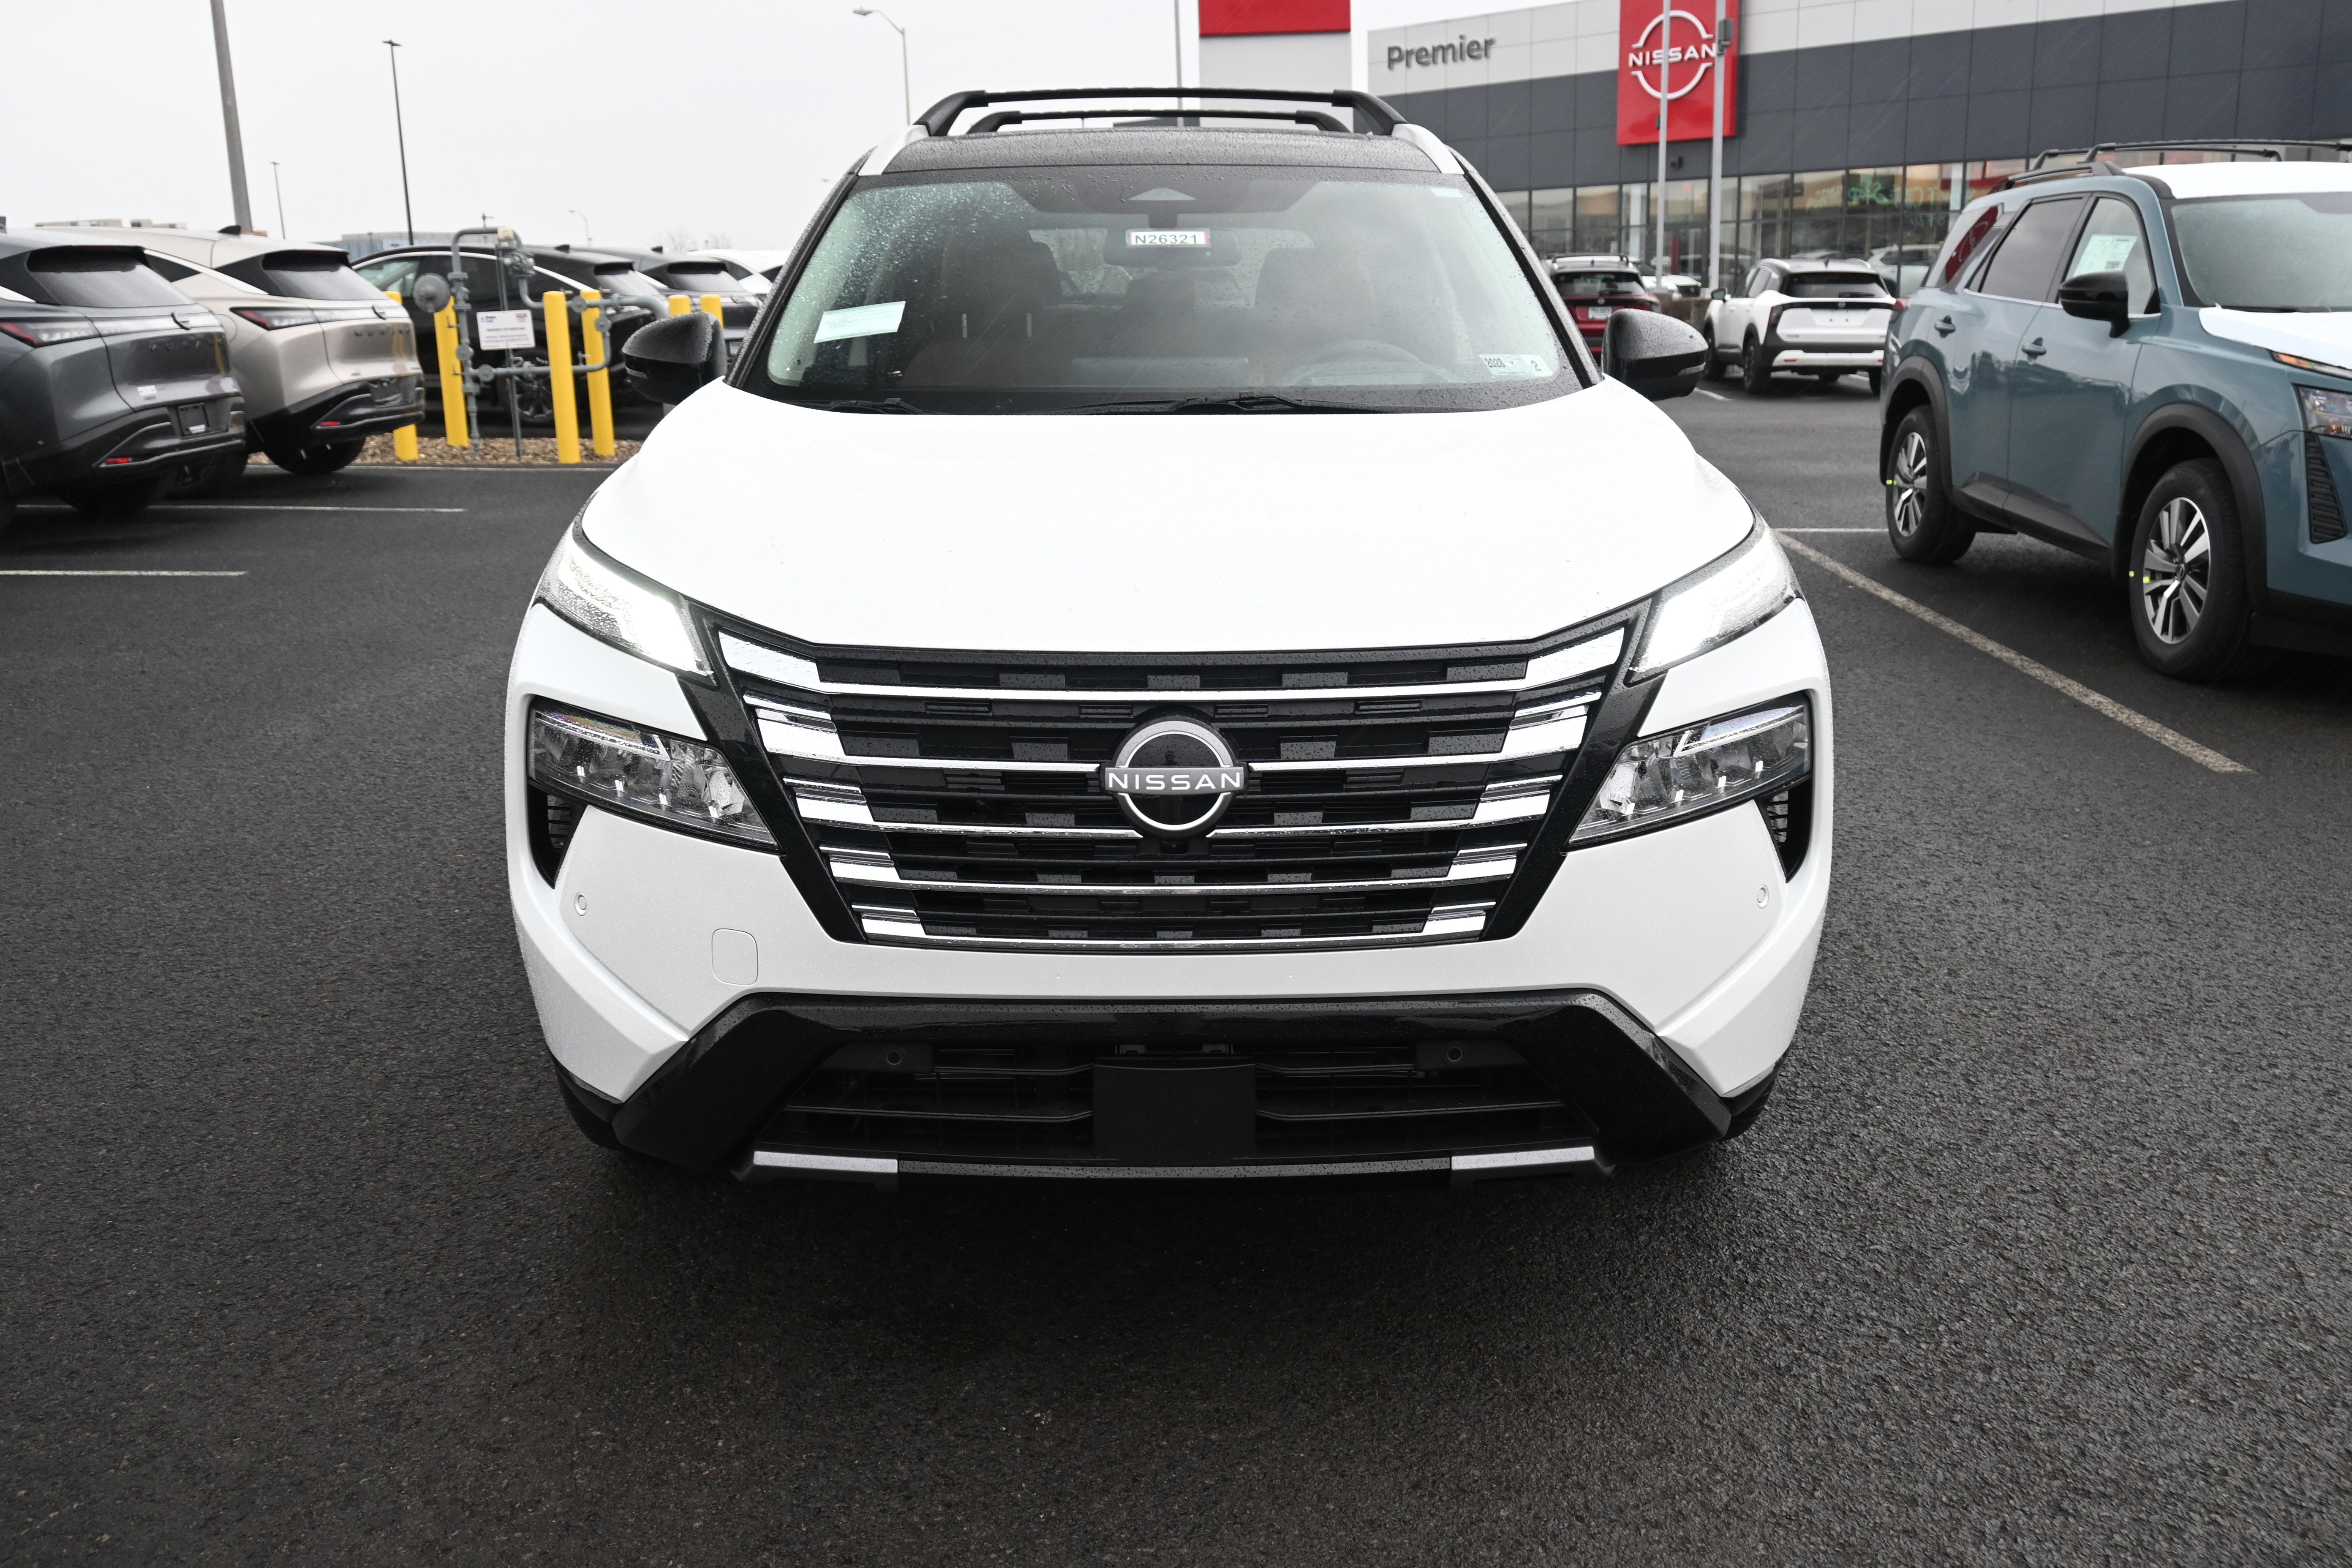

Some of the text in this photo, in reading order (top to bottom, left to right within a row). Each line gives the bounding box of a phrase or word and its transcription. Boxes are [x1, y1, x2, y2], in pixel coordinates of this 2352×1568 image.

[1388, 34, 1496, 71] Premier
[1628, 43, 1717, 68] NISSAN
[1135, 234, 1197, 244] N26321
[1484, 358, 1506, 368] 2028
[1108, 772, 1240, 790] NISSAN
